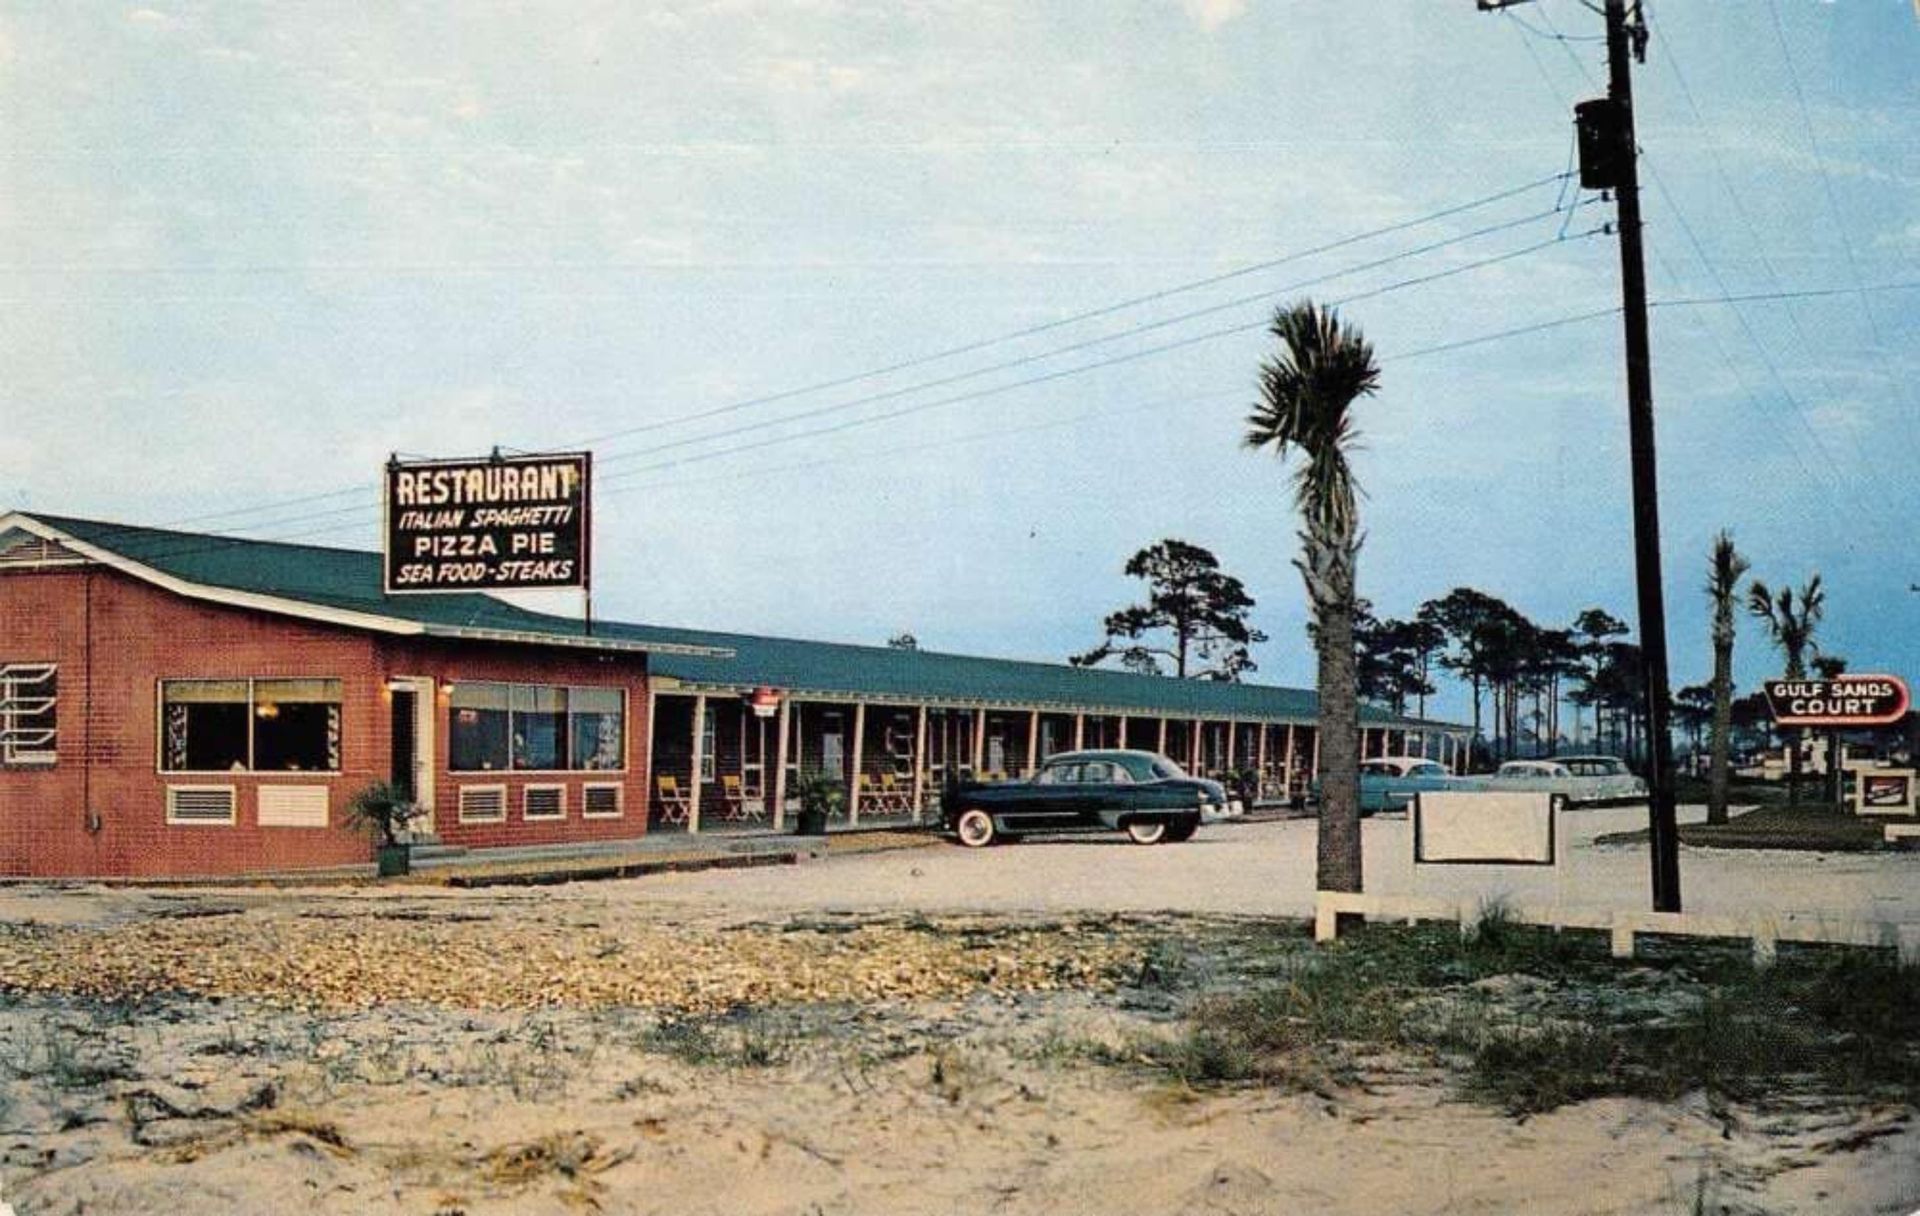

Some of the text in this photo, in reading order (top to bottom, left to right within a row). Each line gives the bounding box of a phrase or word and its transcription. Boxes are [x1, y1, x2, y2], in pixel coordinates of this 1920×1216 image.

[398, 465, 576, 504] RESTAURANT
[400, 506, 572, 528] ITALIAN SPAGHETTI
[415, 533, 555, 556] PIZZA PIE
[397, 565, 432, 583] SEA
[1774, 684, 1892, 697] GULF SANDS
[1791, 699, 1875, 714] COURT
